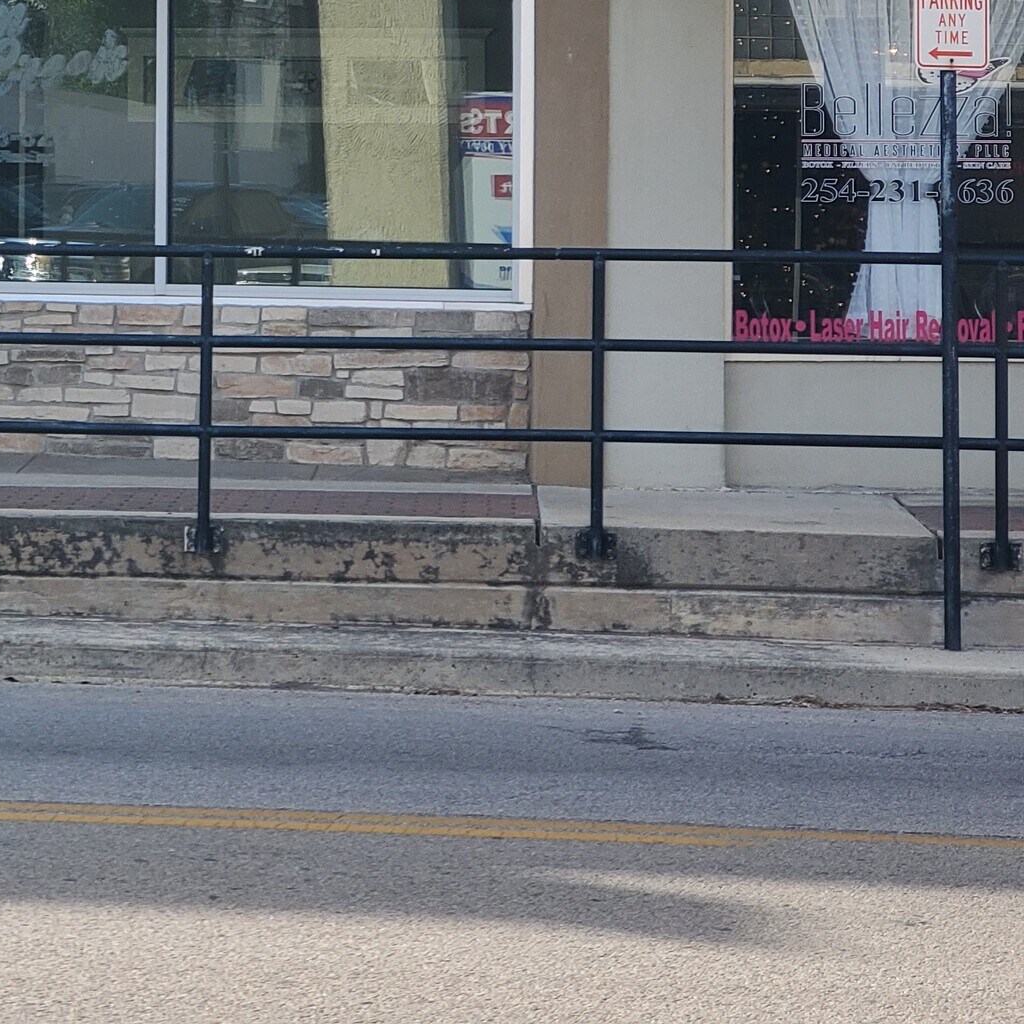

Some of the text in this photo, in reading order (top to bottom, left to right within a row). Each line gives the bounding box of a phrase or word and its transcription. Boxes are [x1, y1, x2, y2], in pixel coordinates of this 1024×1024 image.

[938, 13, 966, 27] ANY
[935, 30, 969, 45] TIME
[803, 144, 1010, 158] MEDICAL AESTHETIS, PLLC
[801, 161, 834, 169] BOTOX
[801, 178, 1014, 204] 254-231-636
[734, 309, 792, 342] Botox
[810, 309, 863, 343] Laser
[870, 310, 910, 343] Hair
[916, 309, 996, 343] Reoval
